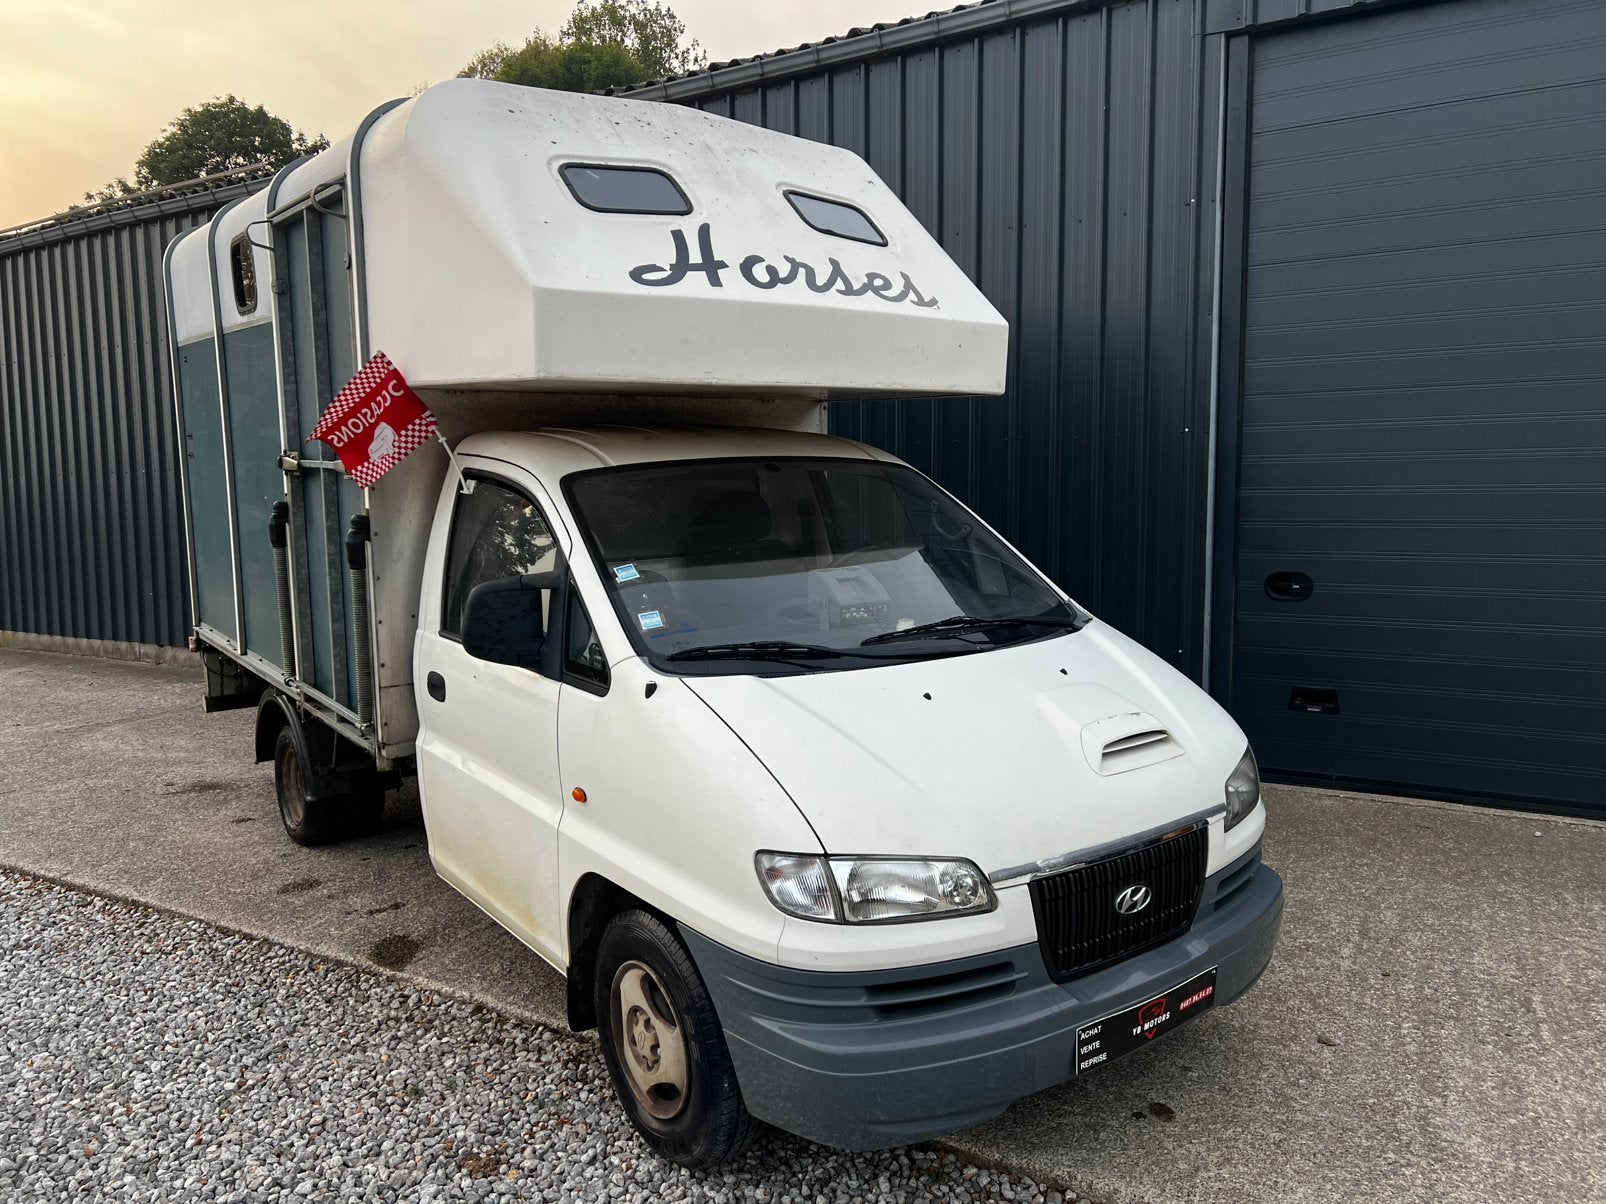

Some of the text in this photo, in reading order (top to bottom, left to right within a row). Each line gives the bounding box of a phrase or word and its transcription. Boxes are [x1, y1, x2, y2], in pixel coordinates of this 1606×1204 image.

[628, 222, 941, 309] Horses
[1080, 1025, 1102, 1040] ACHAT
[1132, 1011, 1171, 1036] YB MOTORS
[1080, 1040, 1101, 1055] VENTE
[1080, 1052, 1108, 1070] REPRISE
